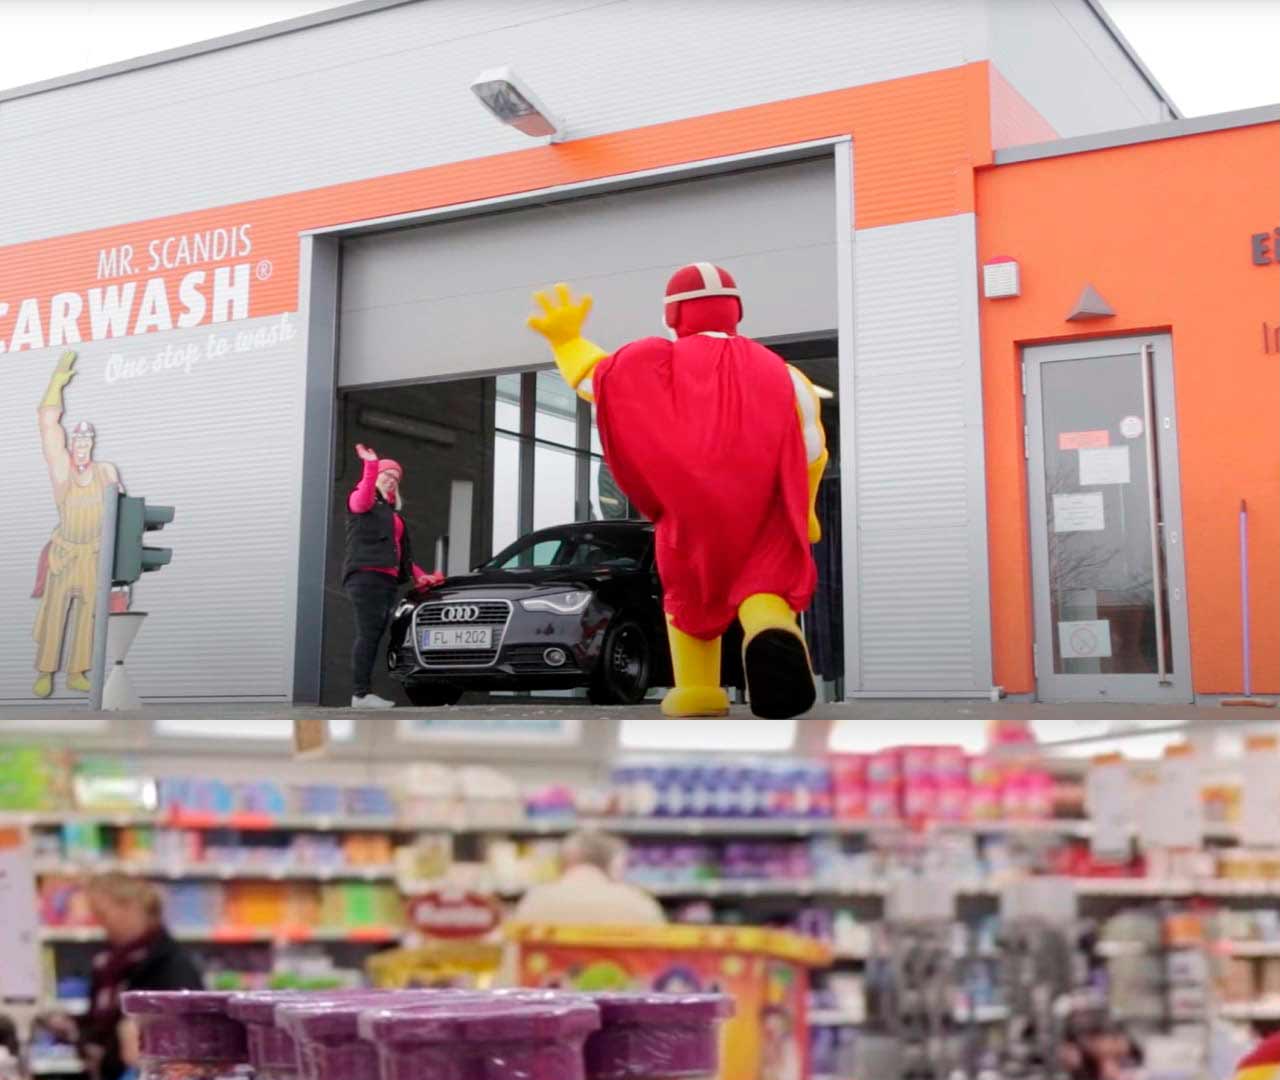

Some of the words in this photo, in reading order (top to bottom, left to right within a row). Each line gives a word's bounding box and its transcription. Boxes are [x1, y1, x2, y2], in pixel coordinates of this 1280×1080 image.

[97, 244, 140, 280] MR.
[148, 224, 252, 271] SCANDIS
[105, 352, 147, 384] One
[152, 342, 200, 373] stop
[207, 333, 228, 360] to
[237, 312, 297, 350] wash
